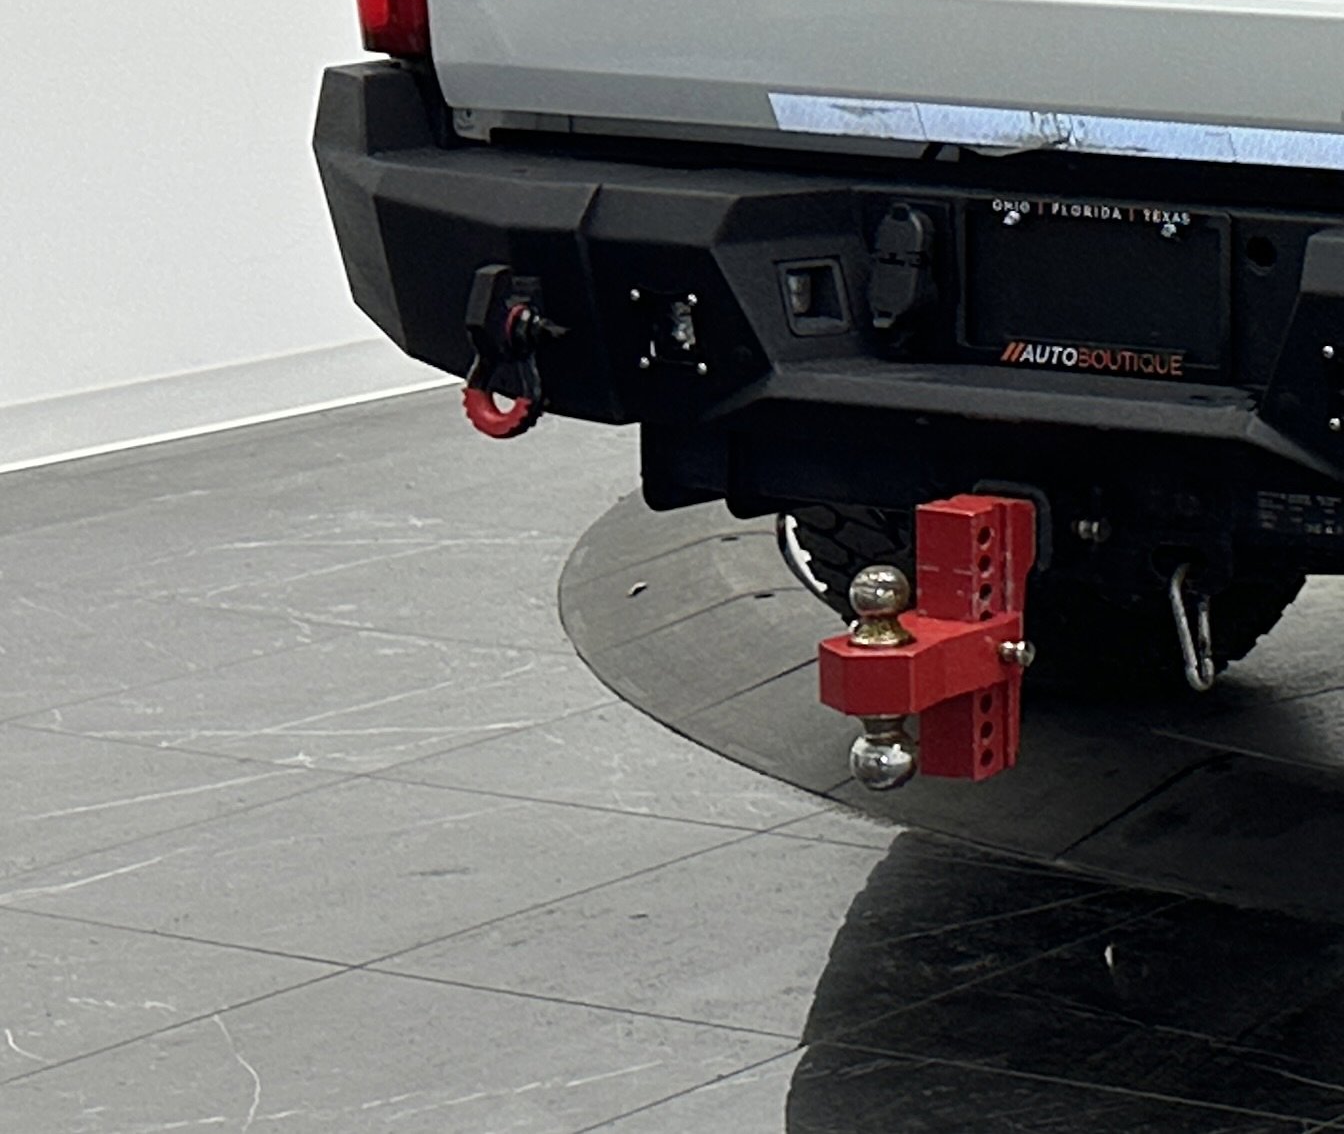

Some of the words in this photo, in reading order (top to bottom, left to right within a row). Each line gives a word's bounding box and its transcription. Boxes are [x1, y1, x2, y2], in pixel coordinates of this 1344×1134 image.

[992, 198, 1030, 213] OHIO
[1051, 202, 1122, 220] FLORIDA
[1143, 208, 1190, 226] TEXAS
